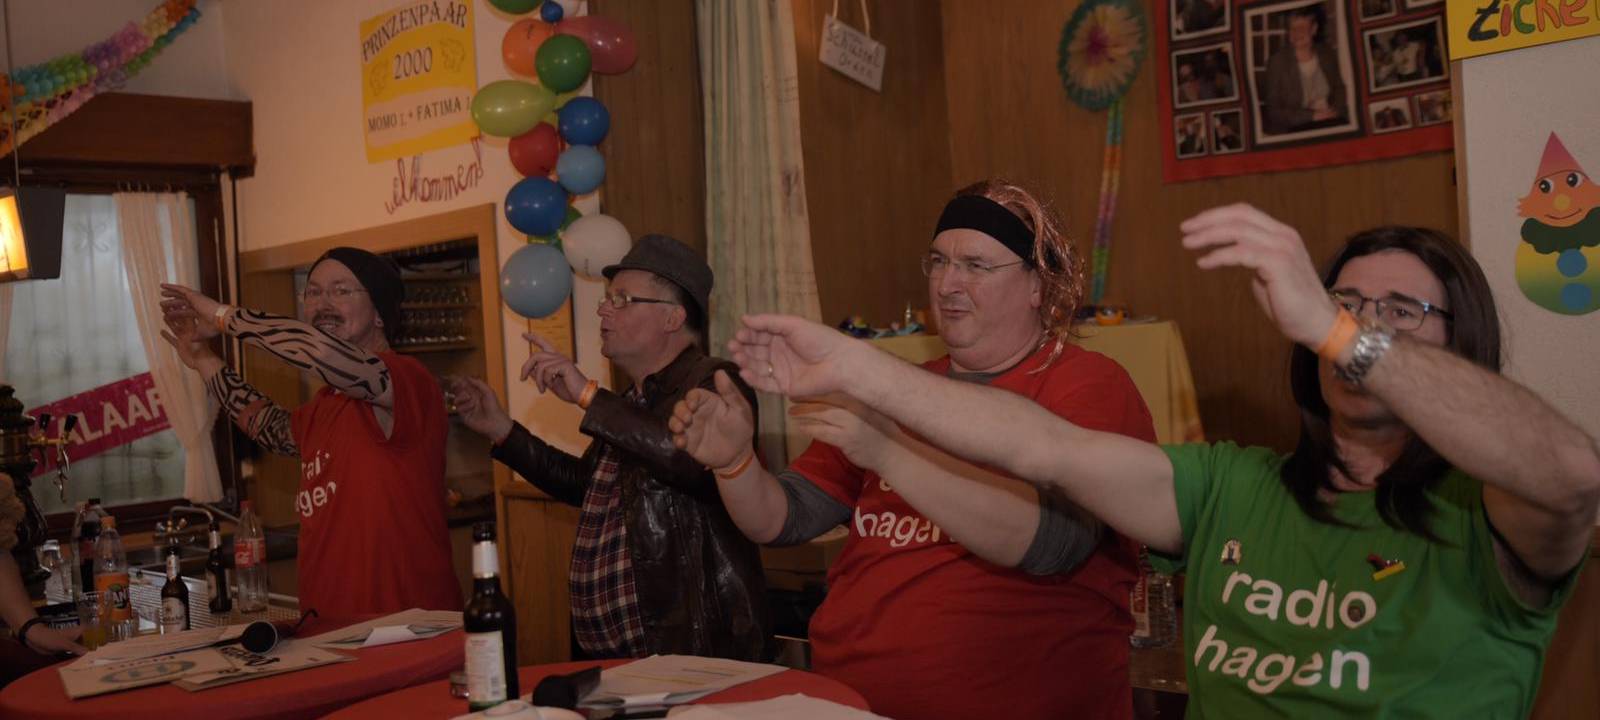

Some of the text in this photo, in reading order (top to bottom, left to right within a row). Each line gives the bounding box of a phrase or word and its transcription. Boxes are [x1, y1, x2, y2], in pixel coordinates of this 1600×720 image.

[362, 1, 468, 62] PRINZENPAAR
[394, 47, 433, 80] 2000
[416, 96, 462, 121] FATIMA
[1221, 571, 1377, 629] radio
[1194, 624, 1371, 694] hagen
